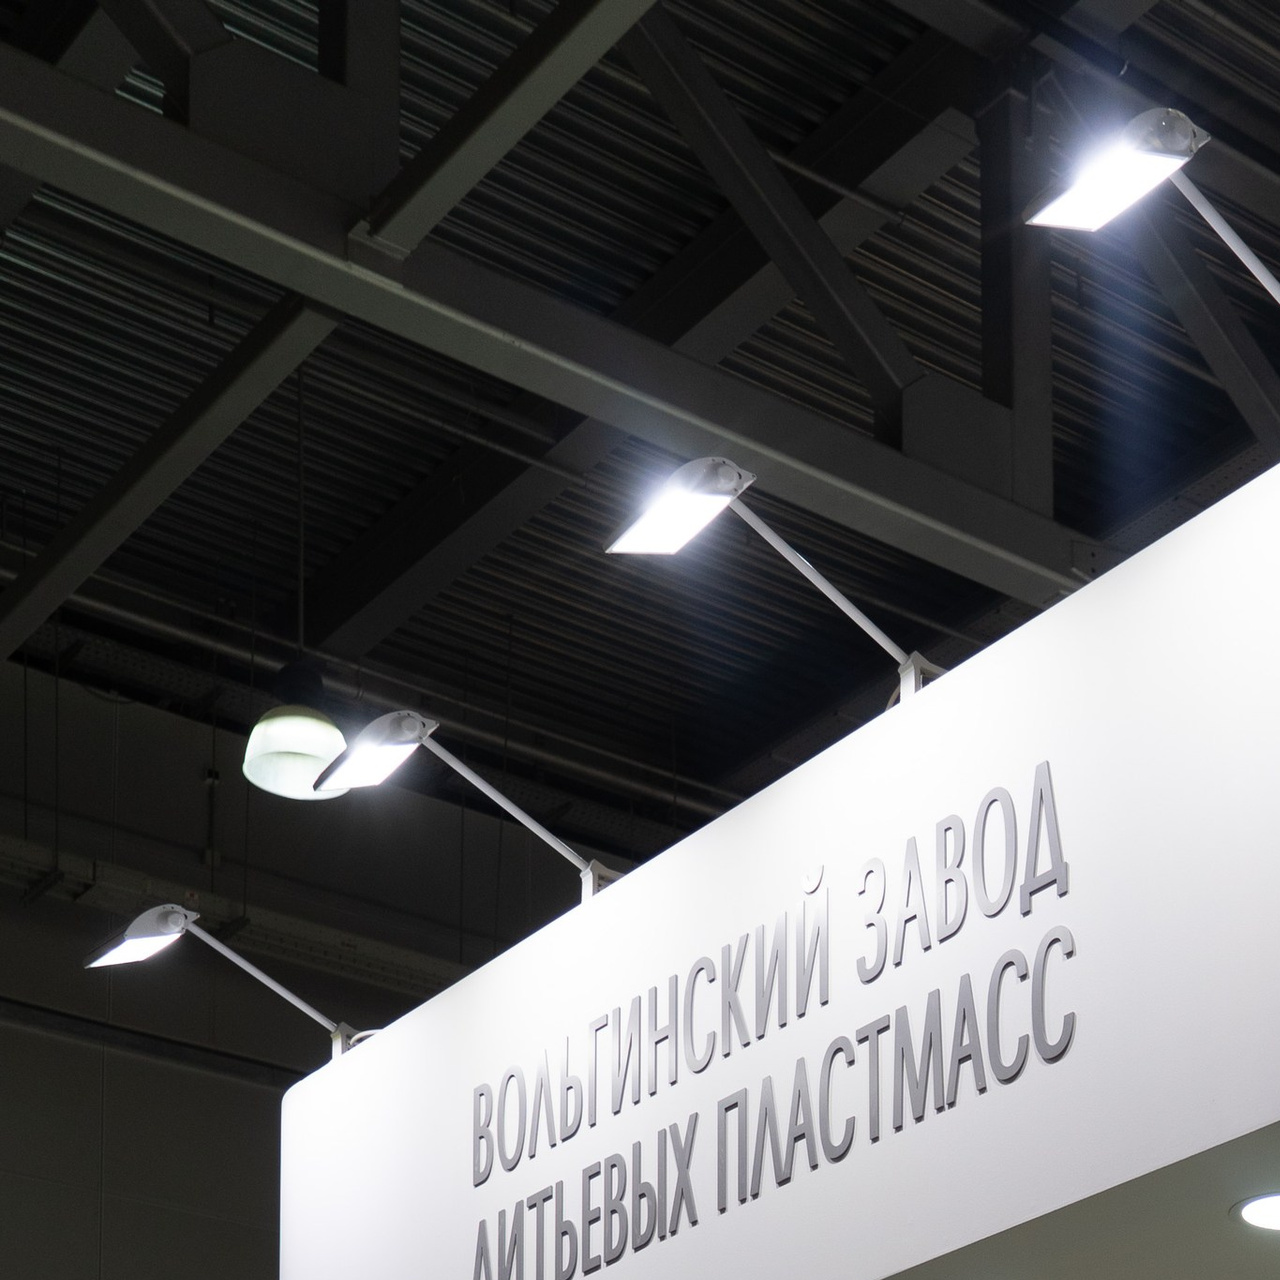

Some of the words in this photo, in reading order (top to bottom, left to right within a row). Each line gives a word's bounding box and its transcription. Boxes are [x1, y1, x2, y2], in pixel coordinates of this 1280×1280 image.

[473, 864, 829, 1188] ВОЛЬГИНСКИЙ
[856, 760, 1070, 985] ЗАВОД
[717, 925, 1076, 1215] ПЛАСТМАСС
